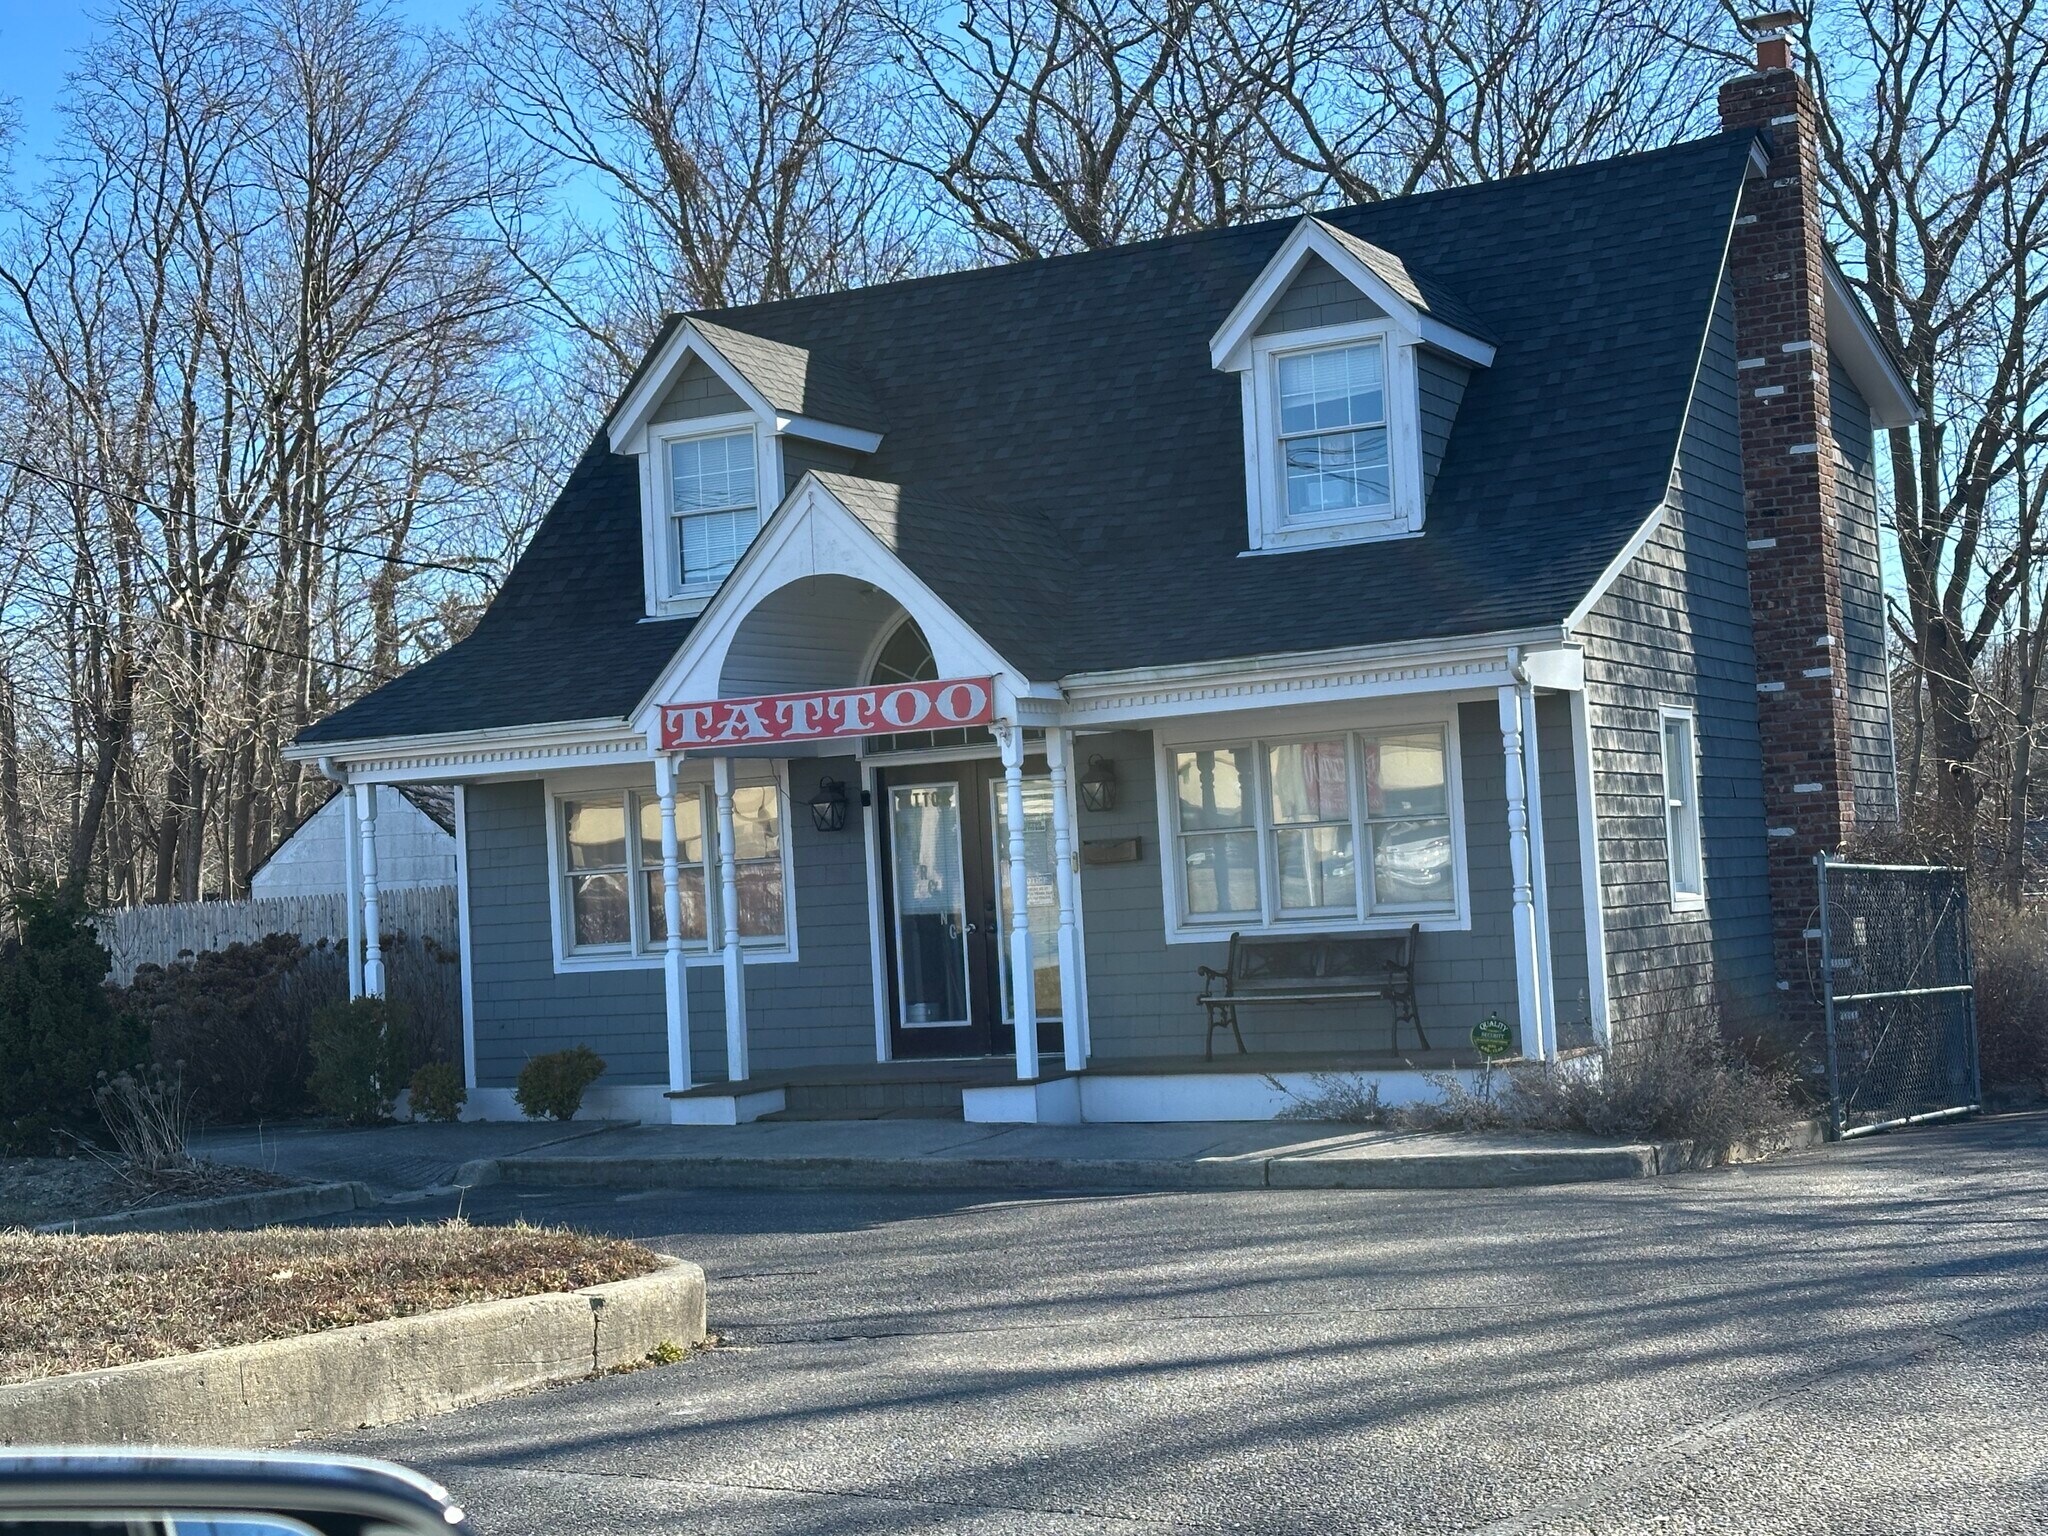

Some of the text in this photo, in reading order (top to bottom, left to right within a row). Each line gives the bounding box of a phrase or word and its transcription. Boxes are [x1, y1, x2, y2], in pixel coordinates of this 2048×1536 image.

[666, 683, 988, 746] TATTOO
[1479, 1020, 1508, 1032] QUALITY
[1481, 1031, 1505, 1040] SECURITY
